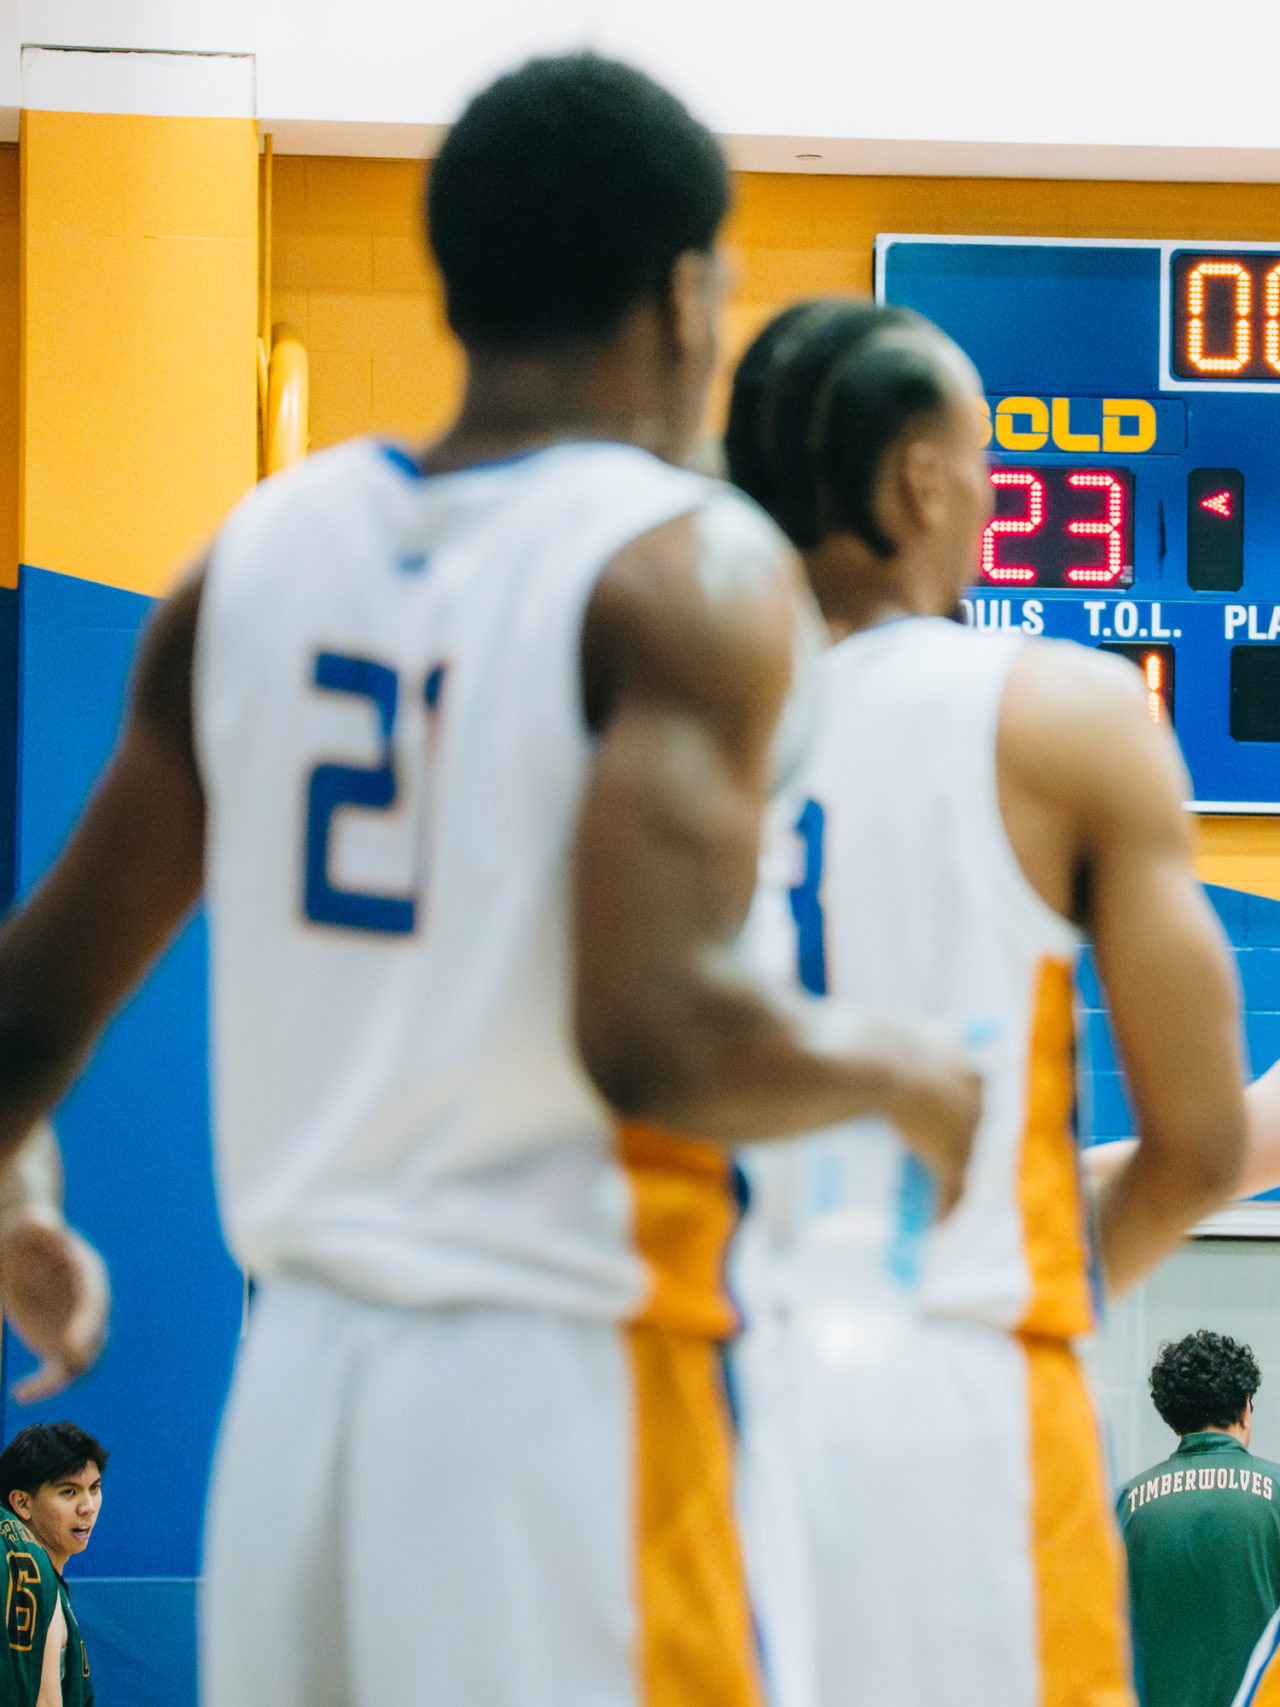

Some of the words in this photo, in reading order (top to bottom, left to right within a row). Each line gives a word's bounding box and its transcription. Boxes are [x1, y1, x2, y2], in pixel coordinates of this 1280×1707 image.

[980, 471, 1124, 583] 23
[1084, 601, 1182, 638] T.O.L.
[1128, 1468, 1273, 1513] TIMBERWOLVES
